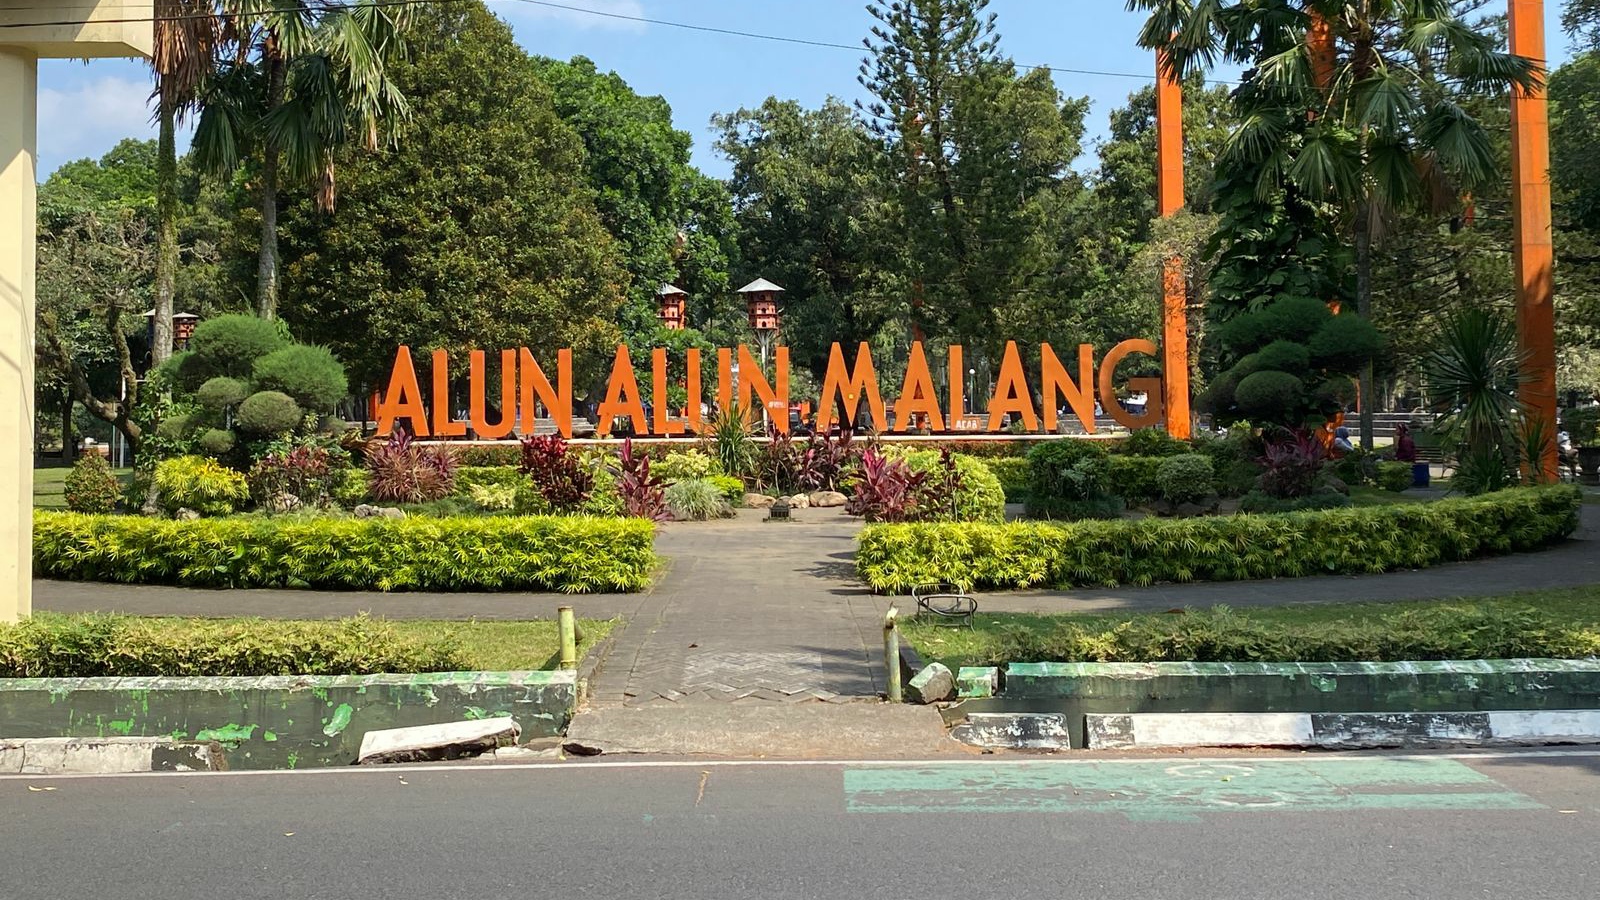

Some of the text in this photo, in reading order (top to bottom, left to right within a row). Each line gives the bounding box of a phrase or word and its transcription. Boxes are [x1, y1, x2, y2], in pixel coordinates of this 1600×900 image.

[378, 339, 1161, 438] ALUN ALUN MALANG
